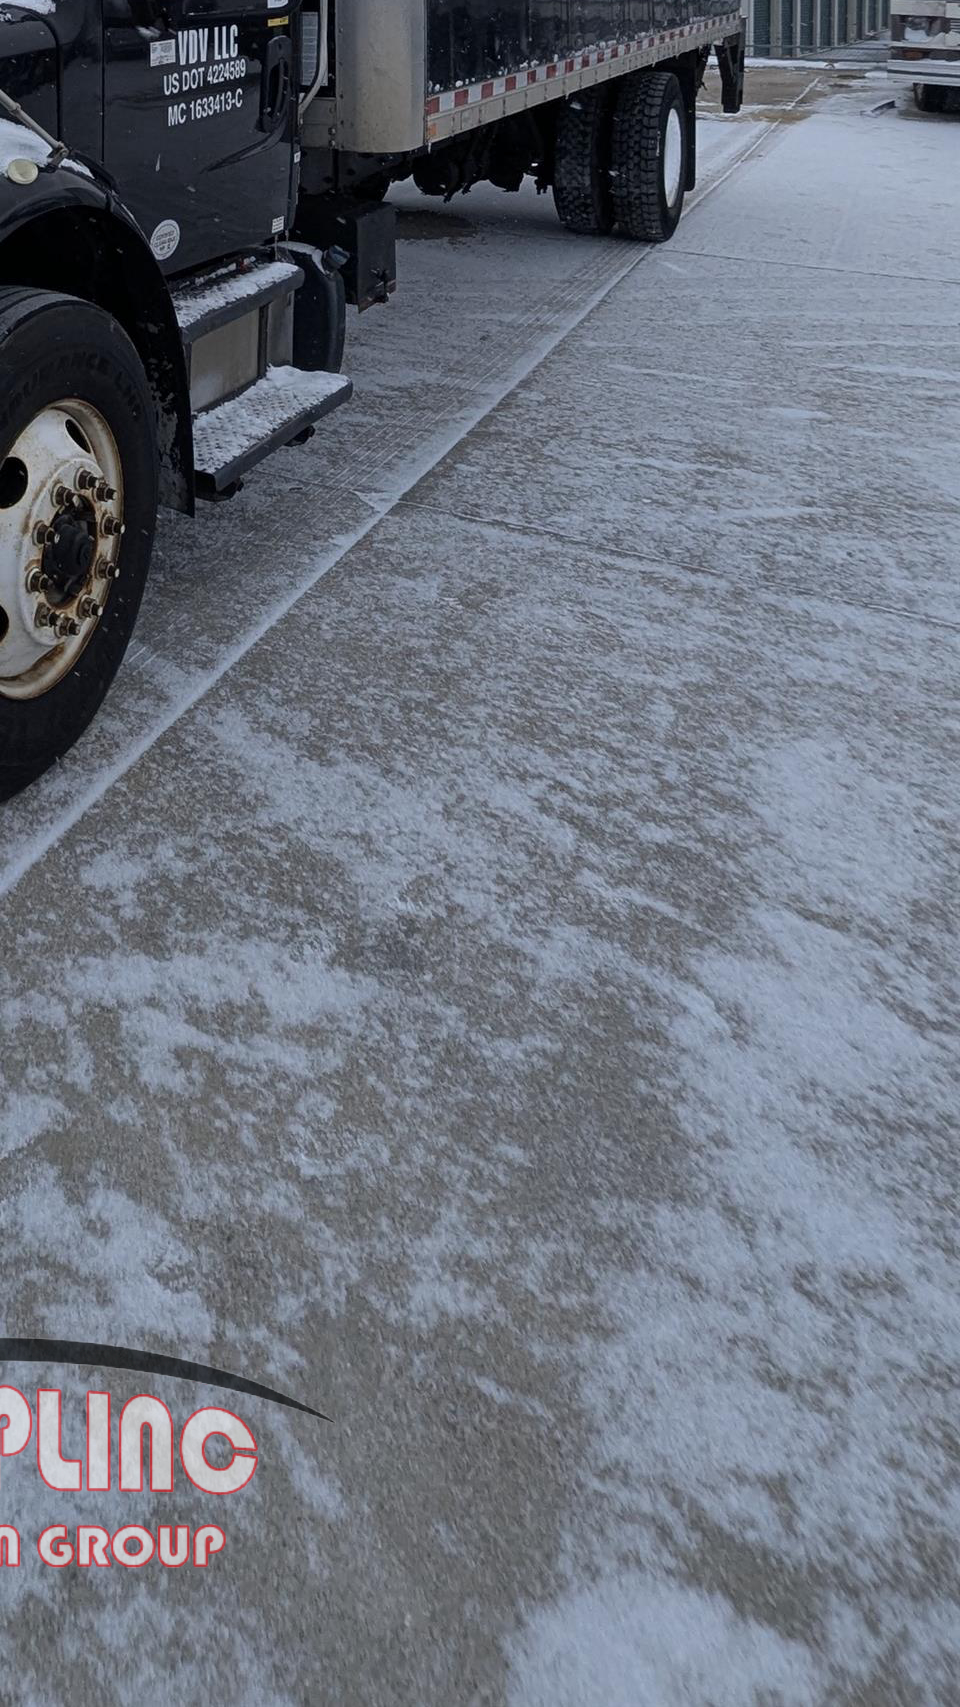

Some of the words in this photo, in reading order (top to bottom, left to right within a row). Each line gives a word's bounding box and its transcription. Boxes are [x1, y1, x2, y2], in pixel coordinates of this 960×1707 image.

[178, 28, 209, 65] VDV
[214, 24, 238, 60] LLC
[163, 72, 180, 96] US
[182, 67, 205, 92] DOT
[207, 58, 247, 85] 4224589
[168, 102, 187, 127] MC
[190, 87, 243, 120] 1633413-C
